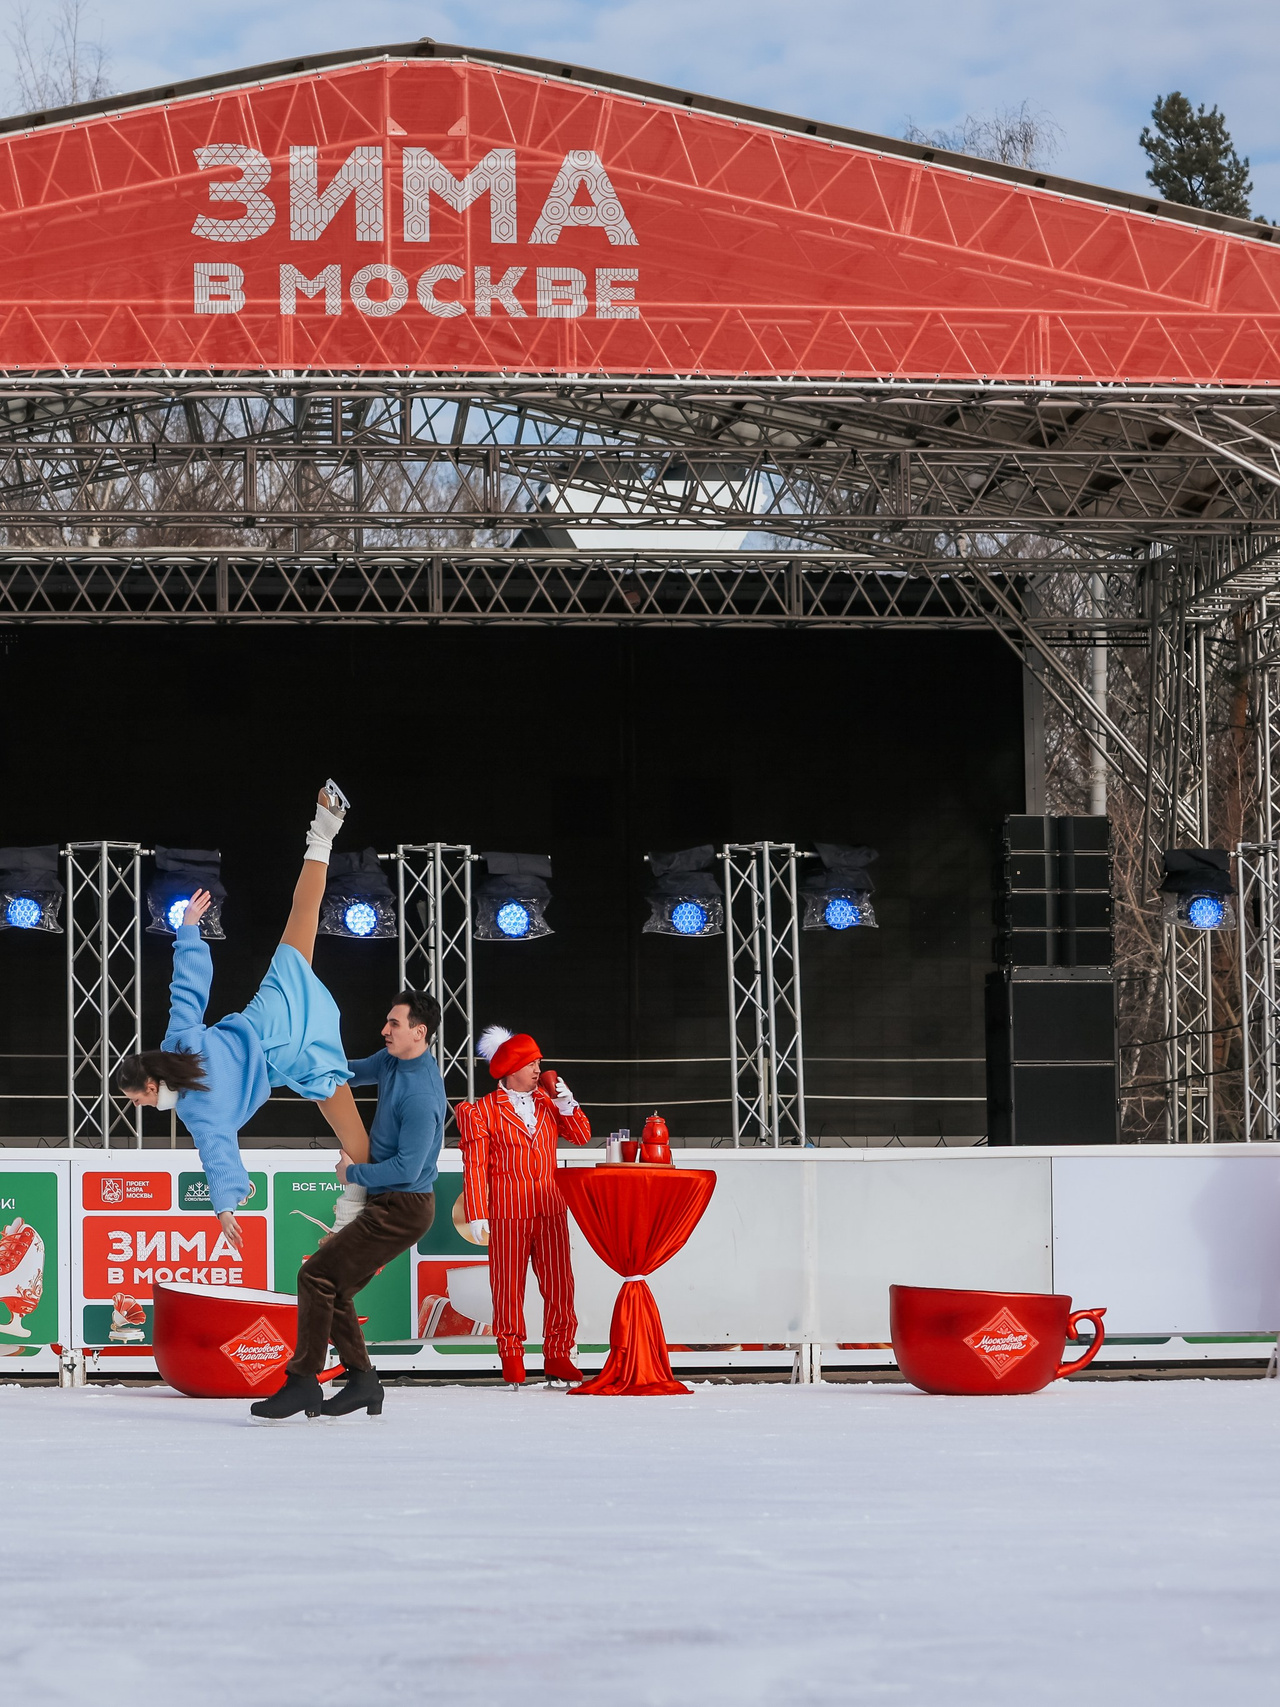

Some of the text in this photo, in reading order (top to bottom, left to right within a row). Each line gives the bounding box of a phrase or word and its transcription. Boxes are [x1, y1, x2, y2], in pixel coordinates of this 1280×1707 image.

[190, 142, 640, 246] ЗИМА
[193, 262, 640, 320] В МОСКВЕ
[292, 1182, 317, 1192] ВСЕ
[106, 1230, 243, 1262] ЗИМА
[107, 1267, 243, 1284] В МОСКВЕ
[230, 1343, 285, 1356] Московское
[974, 1333, 1028, 1349] Московское
